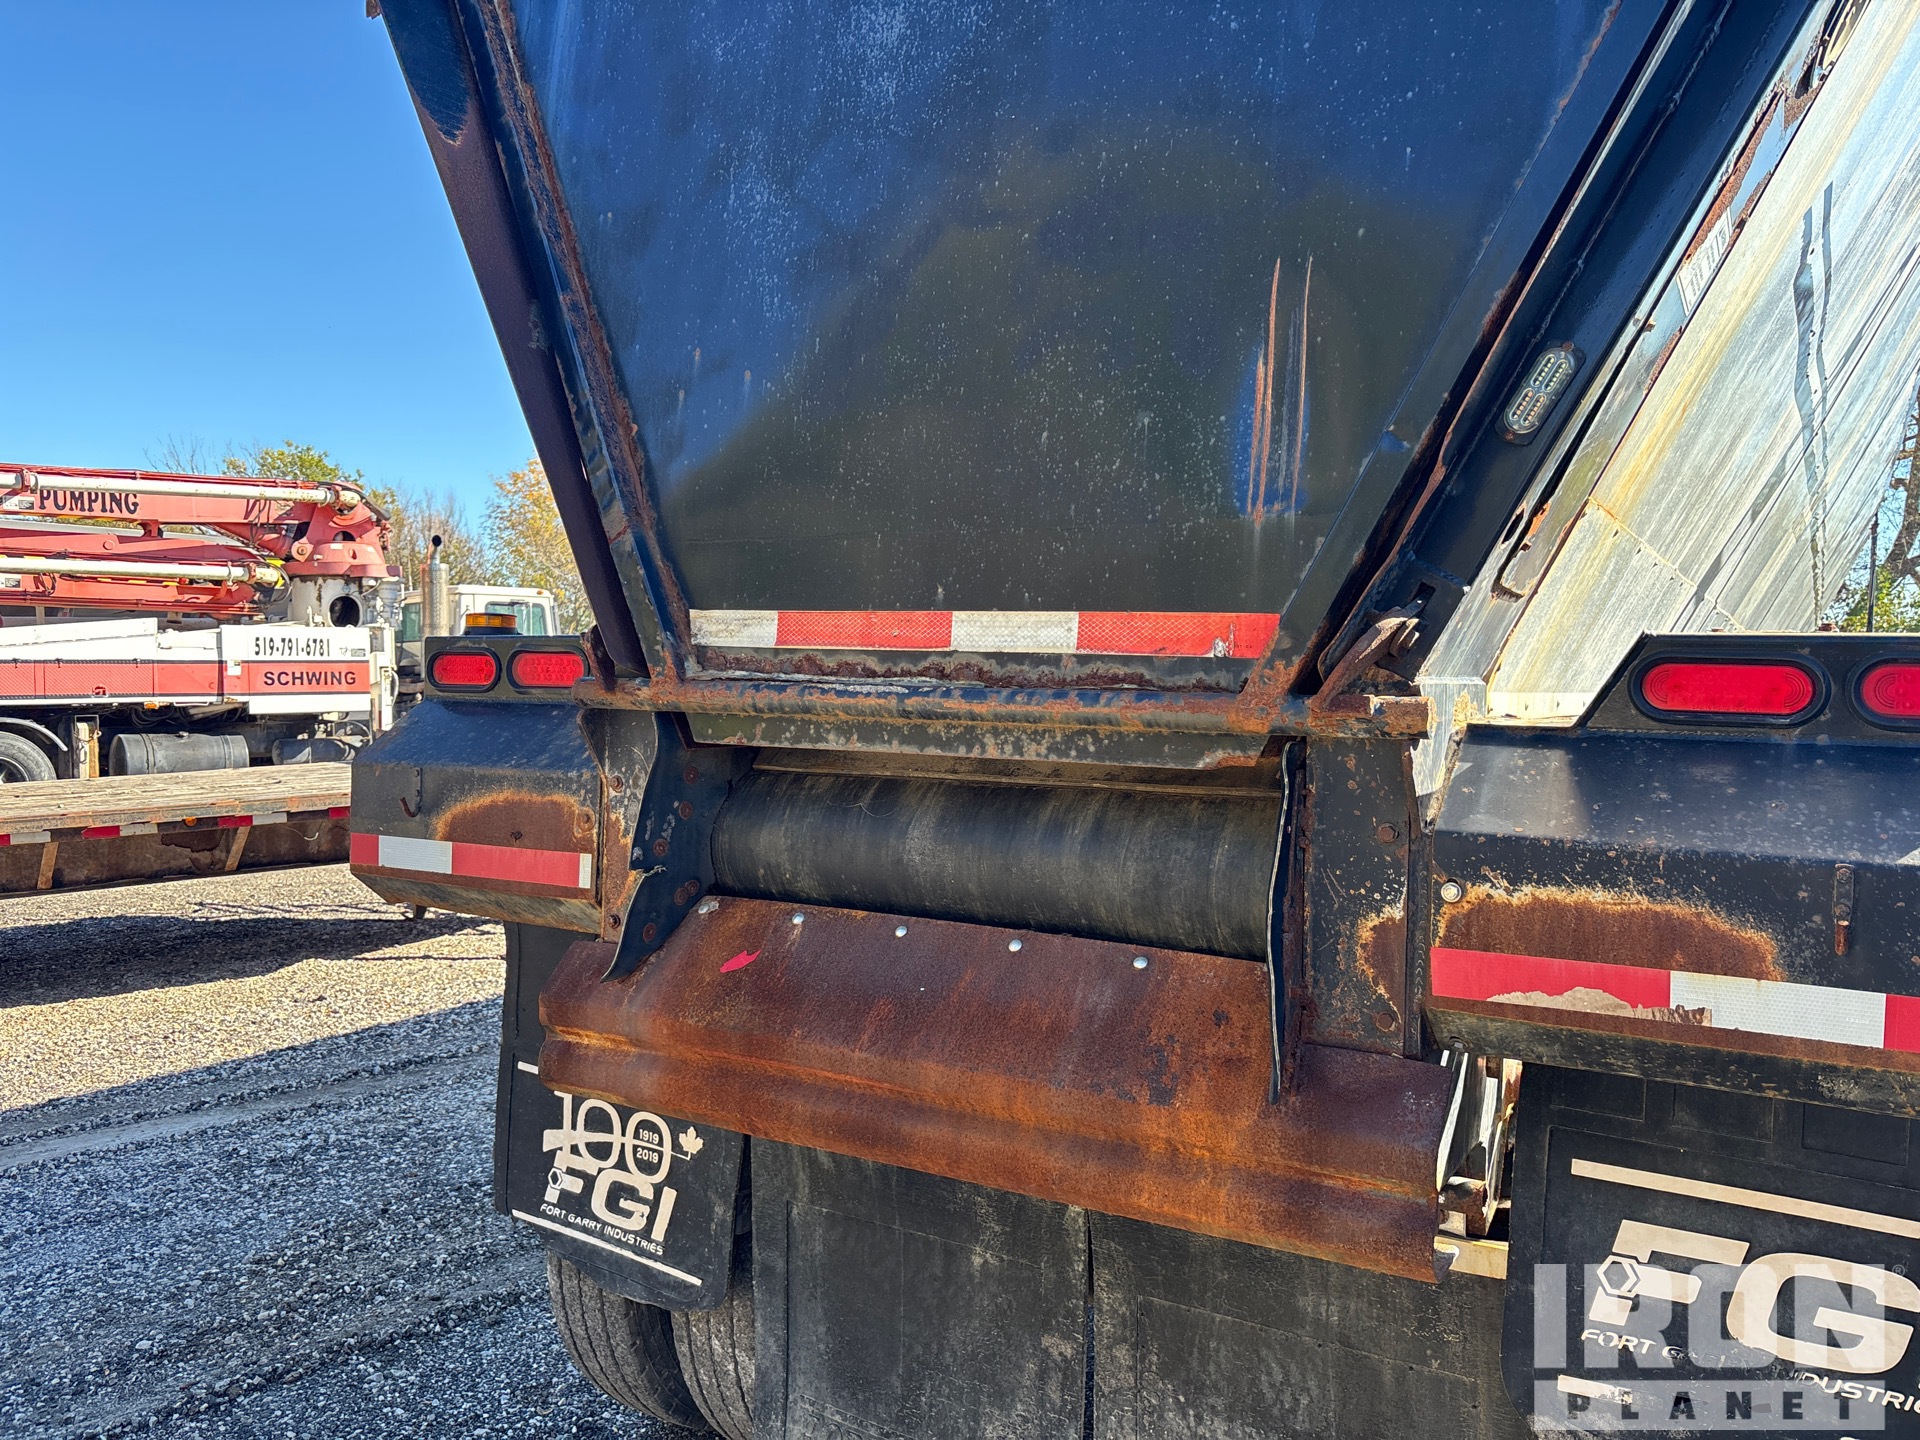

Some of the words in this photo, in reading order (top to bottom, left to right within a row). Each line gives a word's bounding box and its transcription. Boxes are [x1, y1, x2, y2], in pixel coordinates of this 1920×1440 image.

[39, 489, 139, 515] PUMPING
[254, 636, 330, 657] 519-791-6781
[263, 670, 356, 686] SCHWING
[638, 1128, 660, 1145] 1919
[636, 1147, 659, 1164] 2019
[543, 1149, 678, 1242] FGI
[540, 1203, 567, 1220] FORT
[567, 1212, 602, 1233] GARRY
[603, 1224, 664, 1256] INDUSTRIES
[1580, 1328, 1657, 1355] FORT
